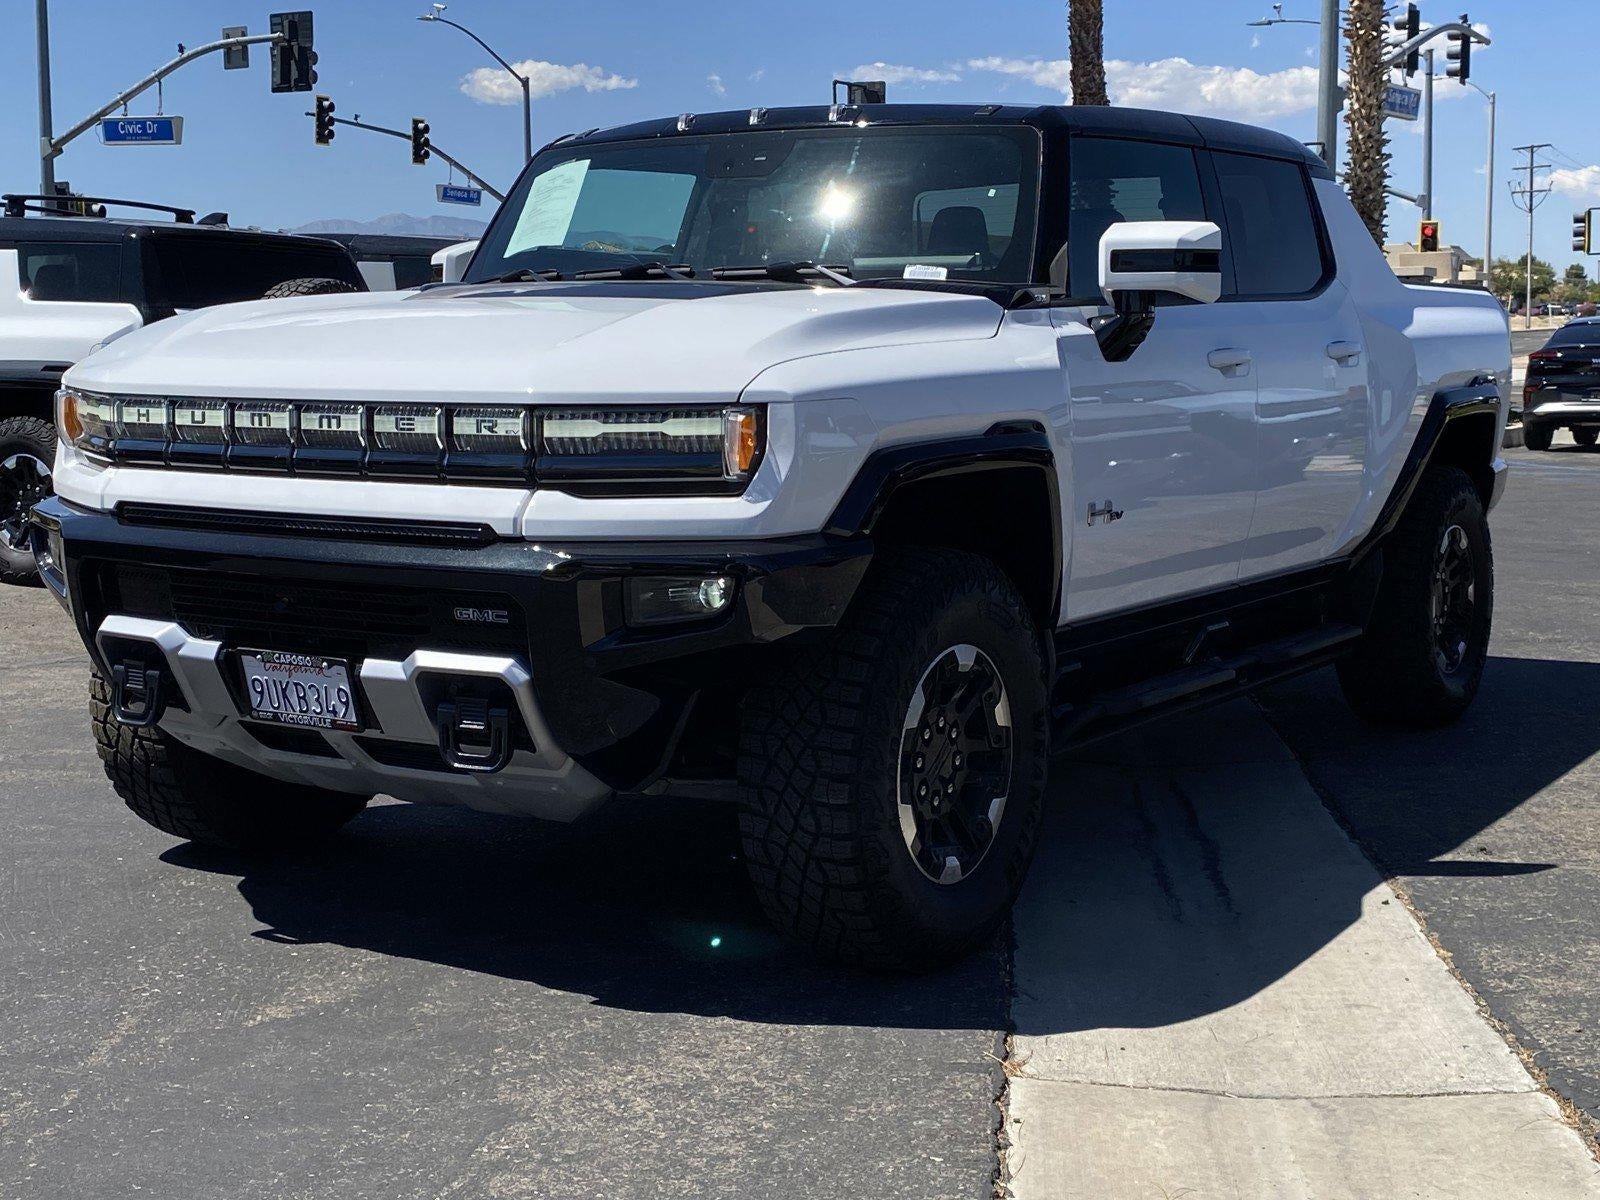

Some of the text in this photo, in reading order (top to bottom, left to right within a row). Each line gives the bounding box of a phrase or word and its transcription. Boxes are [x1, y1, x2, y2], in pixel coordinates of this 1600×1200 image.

[118, 121, 158, 134] Civic Dr
[453, 607, 509, 623] GMC
[251, 675, 350, 719] 9UKB349
[278, 713, 333, 729] VICTORVILLE
